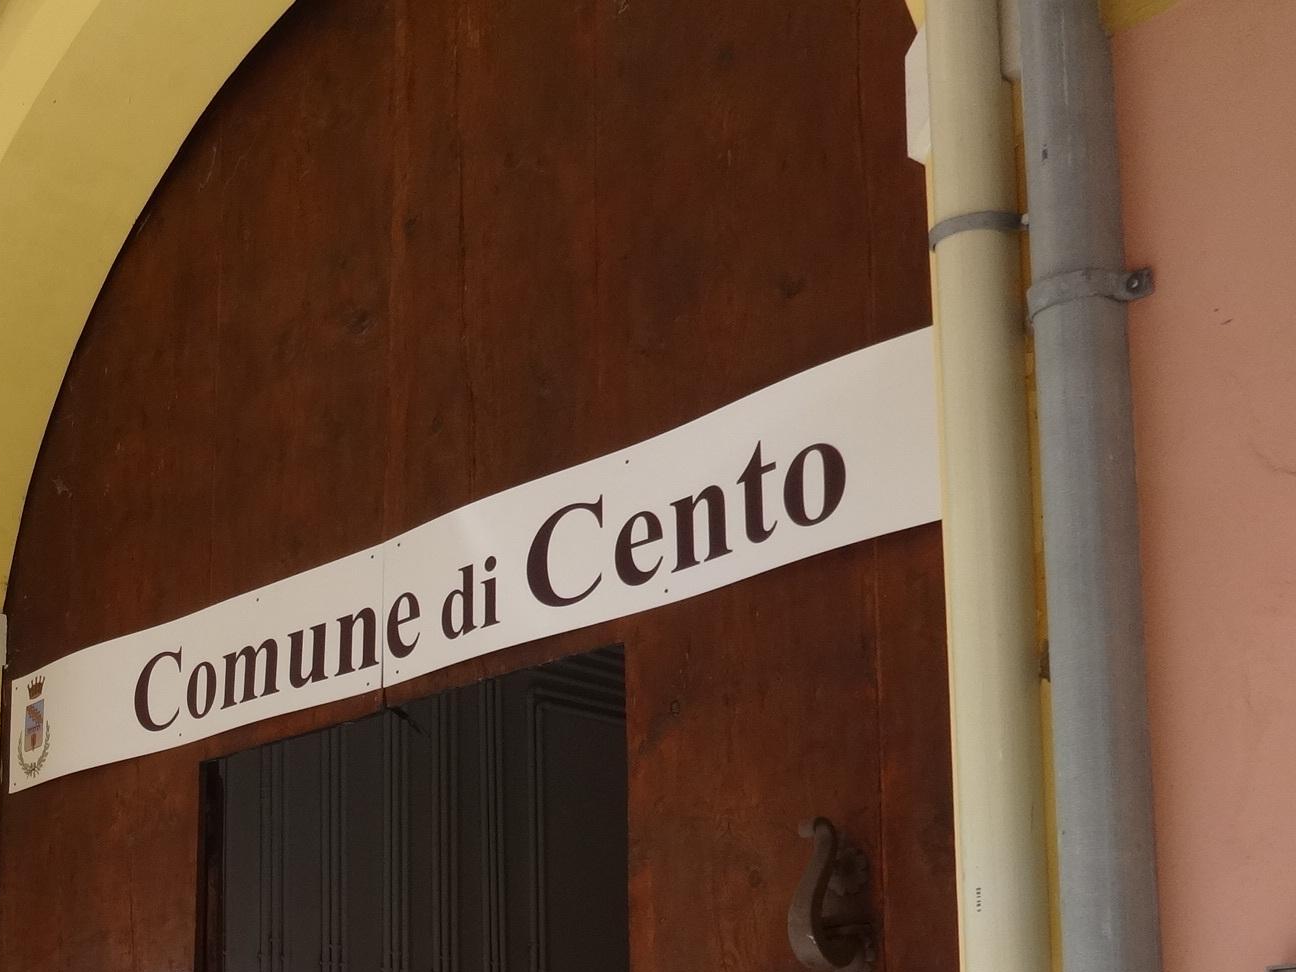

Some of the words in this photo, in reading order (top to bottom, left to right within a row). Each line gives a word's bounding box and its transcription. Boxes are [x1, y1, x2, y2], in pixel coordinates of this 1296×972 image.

[134, 591, 421, 732] Comune
[441, 555, 501, 640] di
[526, 440, 847, 607] Cento
